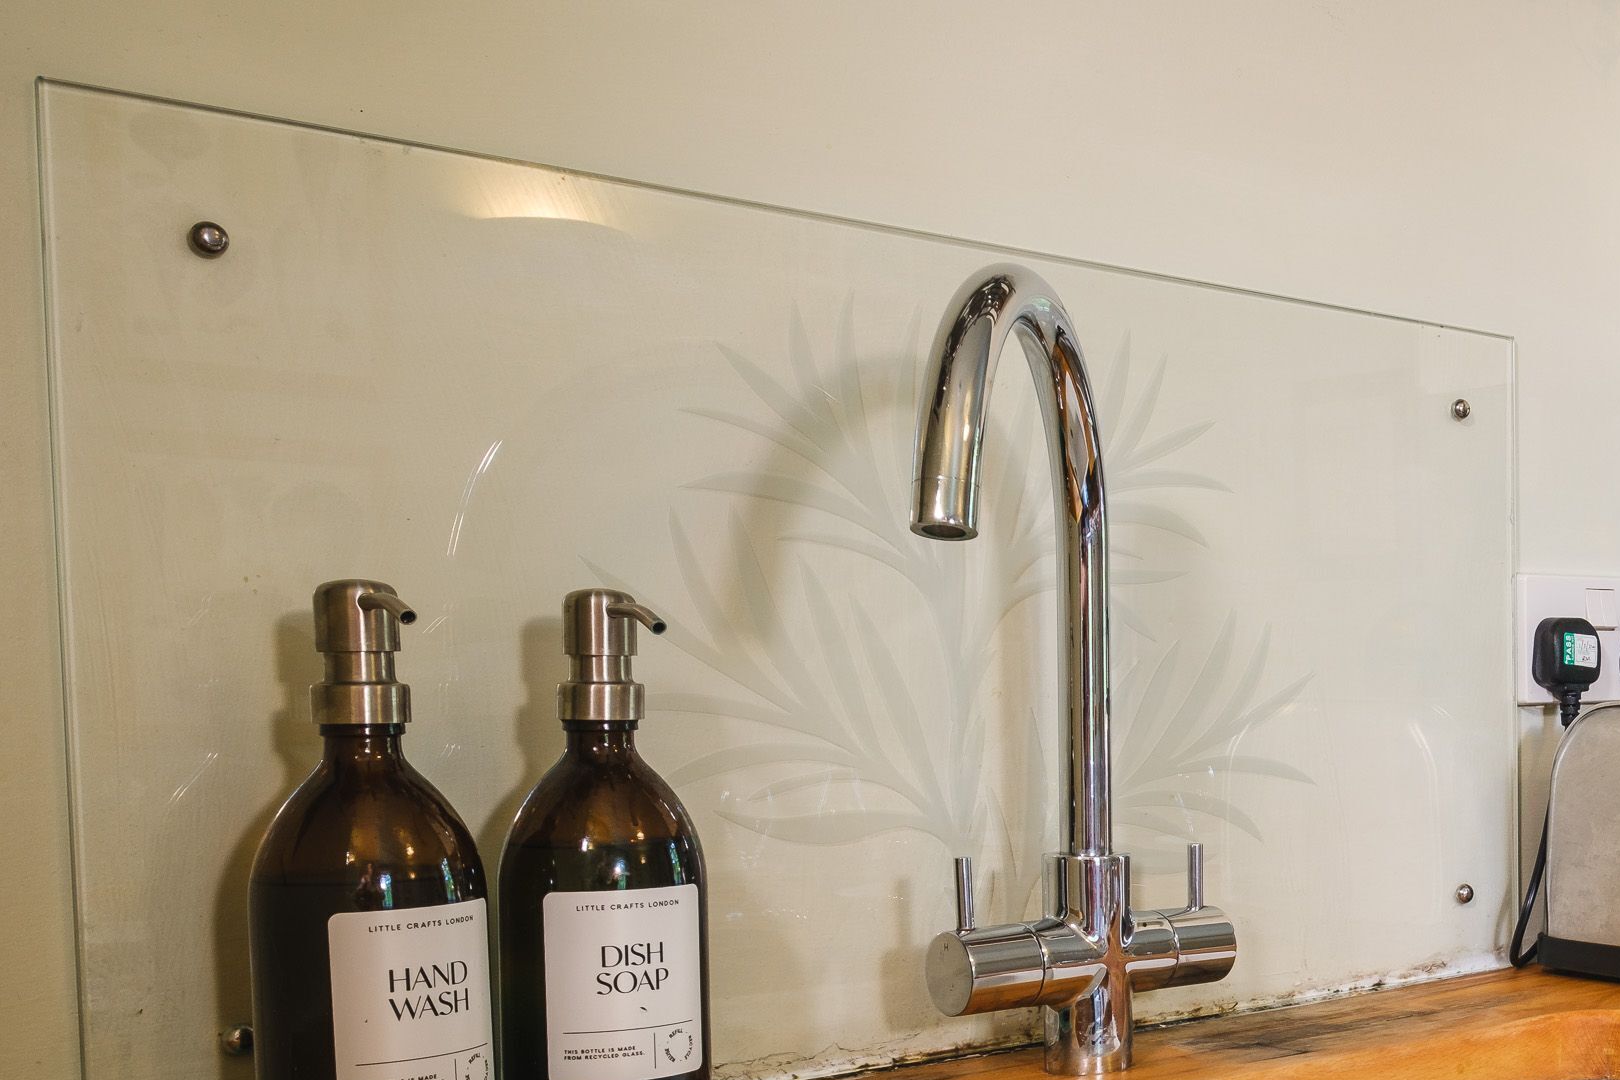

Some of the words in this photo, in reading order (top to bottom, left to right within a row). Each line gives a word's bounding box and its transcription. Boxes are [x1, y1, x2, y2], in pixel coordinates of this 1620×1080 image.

[576, 904, 605, 912] LITTLE
[610, 902, 645, 911] CRAFTS
[648, 899, 679, 908] LONDON
[368, 923, 401, 933] LITTLE
[406, 919, 442, 930] CRAFTS
[445, 914, 474, 926] LONDON
[601, 941, 664, 968] DISH
[388, 960, 468, 993] HAND
[596, 967, 669, 996] SOAP
[388, 987, 469, 1022] WASH
[622, 1050, 646, 1058] GLASS.
